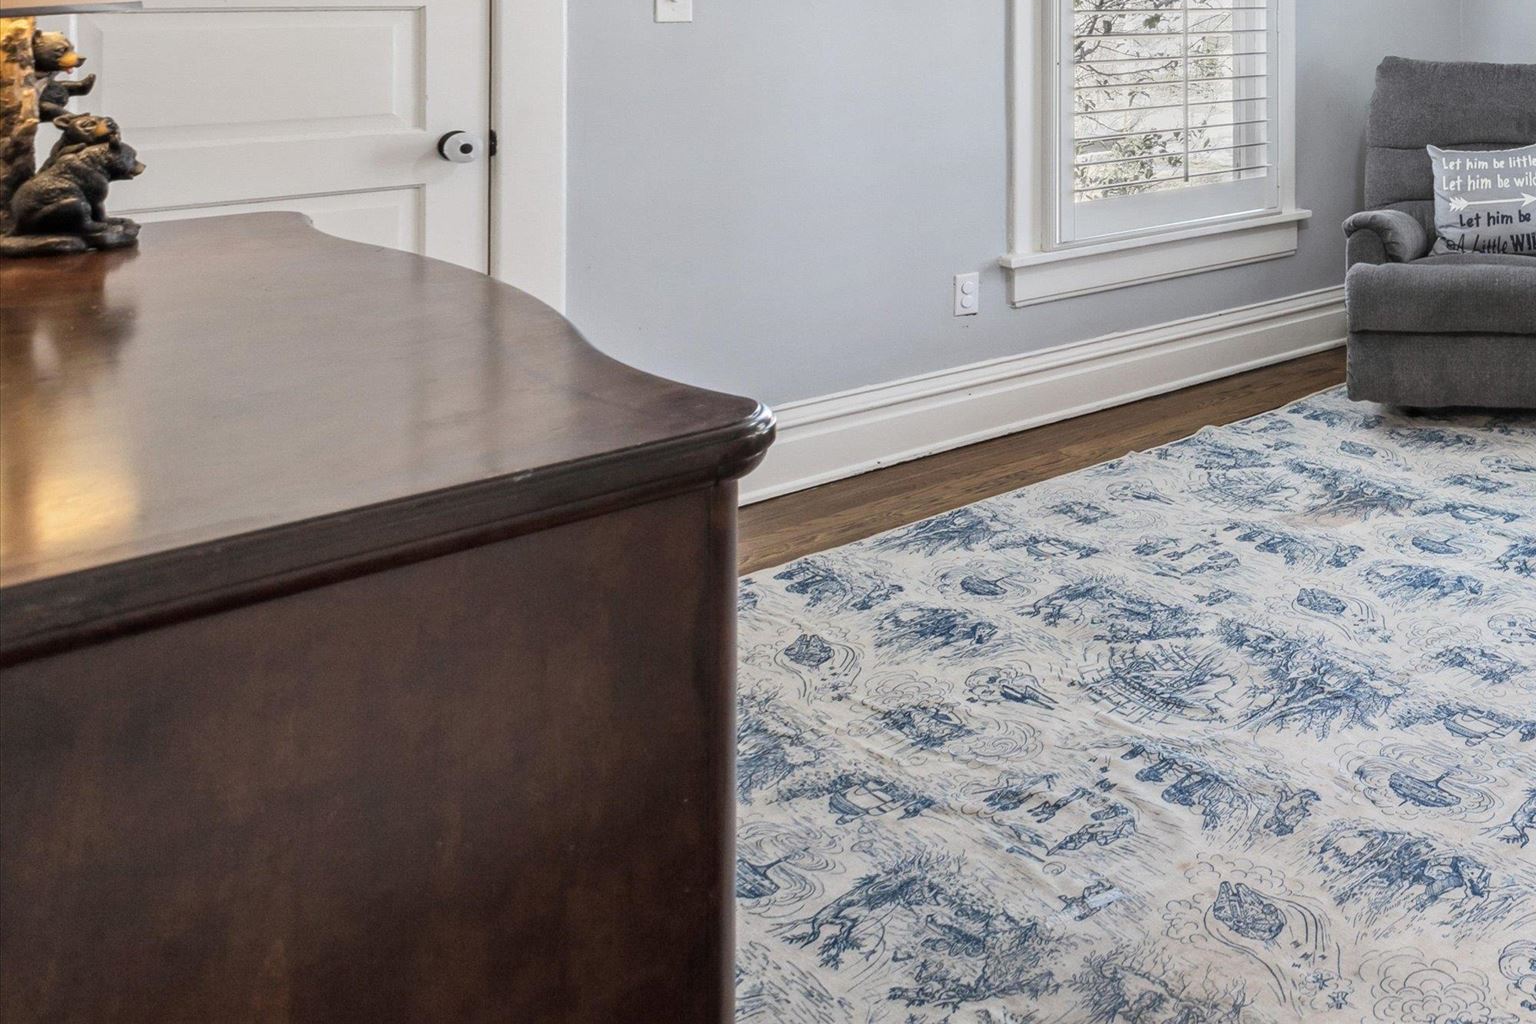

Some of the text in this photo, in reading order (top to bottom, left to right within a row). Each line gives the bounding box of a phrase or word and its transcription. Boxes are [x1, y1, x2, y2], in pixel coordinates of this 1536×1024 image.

[1442, 157, 1462, 170] Let
[1466, 158, 1489, 171] him
[1493, 158, 1505, 169] be
[1443, 175, 1463, 191] Let
[1467, 175, 1492, 191] him
[1497, 174, 1511, 188] be
[1459, 209, 1531, 228] Let him be
[1472, 234, 1508, 254] Little
